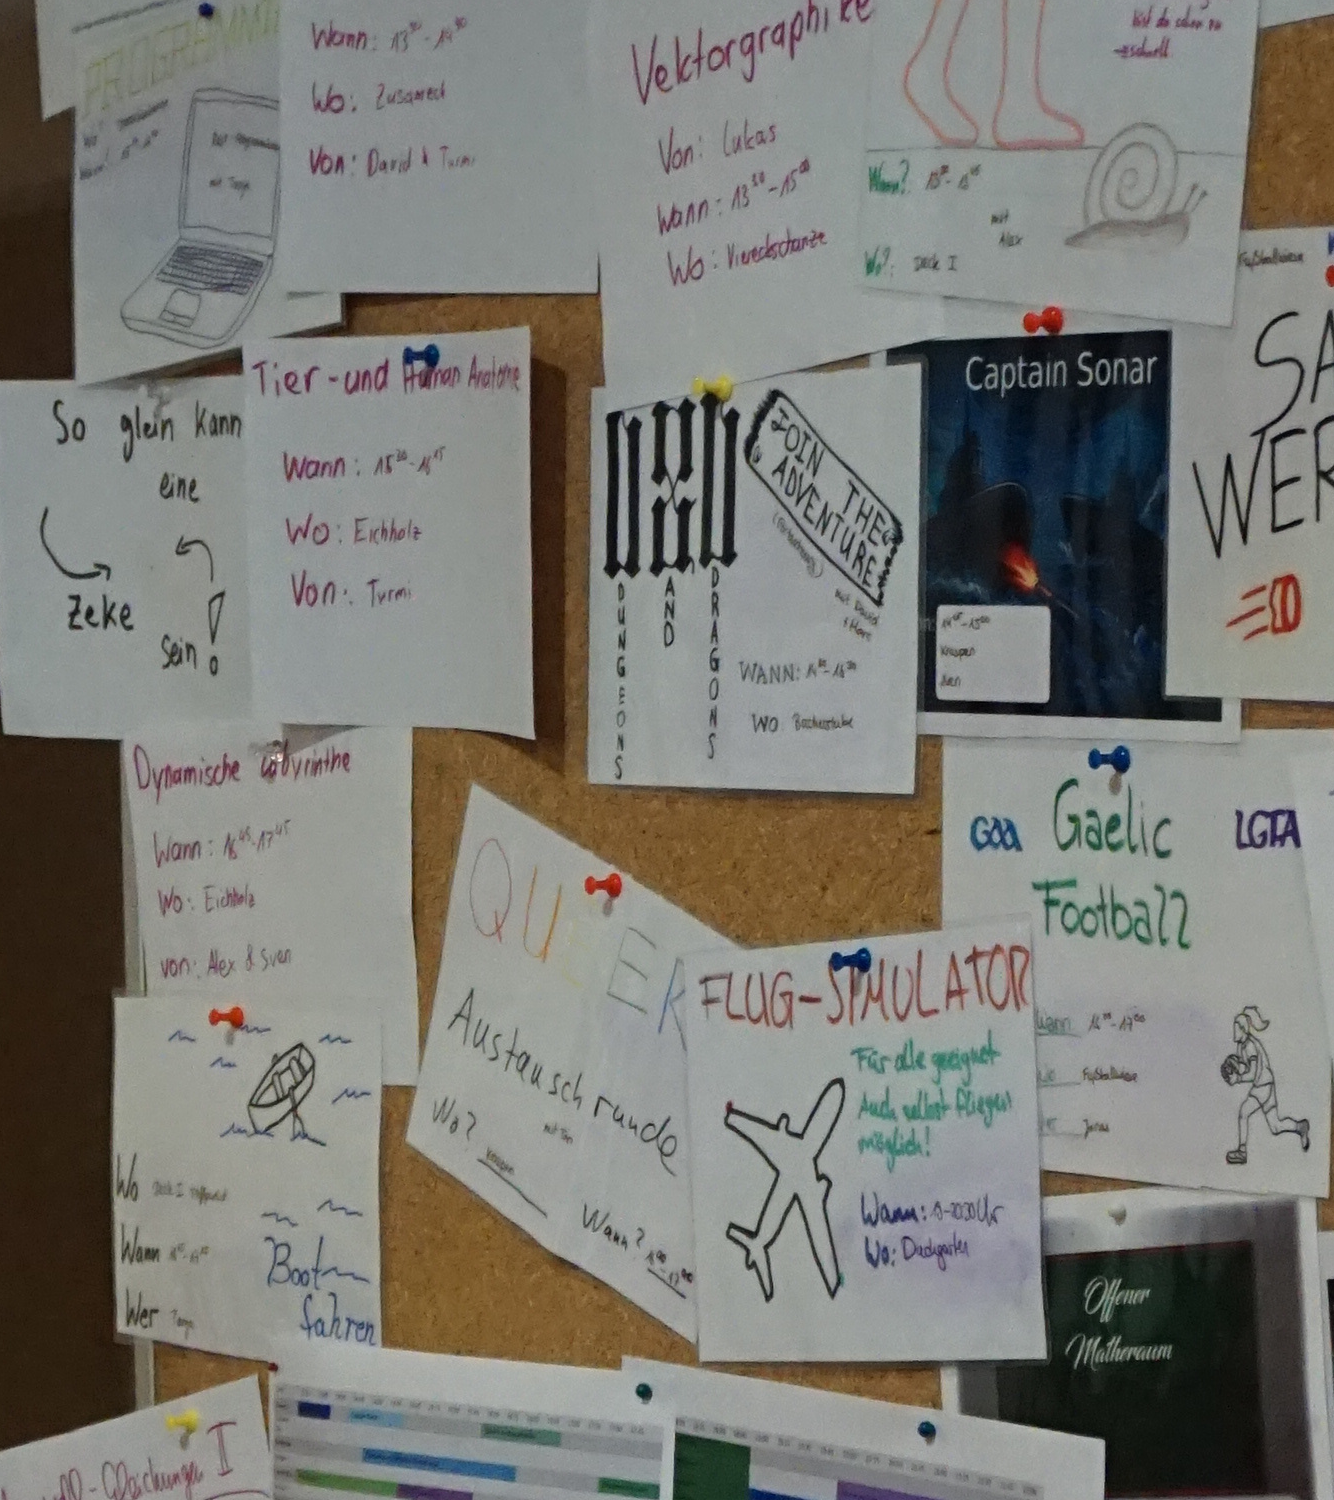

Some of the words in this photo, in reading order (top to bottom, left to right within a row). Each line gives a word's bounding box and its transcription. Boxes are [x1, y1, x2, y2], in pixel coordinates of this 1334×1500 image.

[722, 121, 777, 158] Lukas
[966, 354, 1068, 398] Captain
[1076, 349, 1159, 390] Sonar
[53, 400, 87, 445] So
[158, 471, 200, 504] eine
[770, 405, 825, 474] JOIN
[845, 480, 888, 547] THE
[770, 456, 882, 588] ADVENTURE
[66, 593, 136, 632] Zeke
[663, 576, 675, 649] AND
[705, 566, 721, 761] DRAGONS
[132, 744, 241, 804] Dynamische
[1052, 776, 1174, 860] Gaelic
[1031, 877, 1193, 951] Football
[206, 947, 237, 976] Alex
[698, 942, 1031, 1029] FLUG-SIMULATOR
[264, 1235, 324, 1291] Boot
[299, 1292, 376, 1346] fahren
[1083, 1276, 1151, 1324] Offener
[1067, 1332, 1175, 1373] Matheraum
